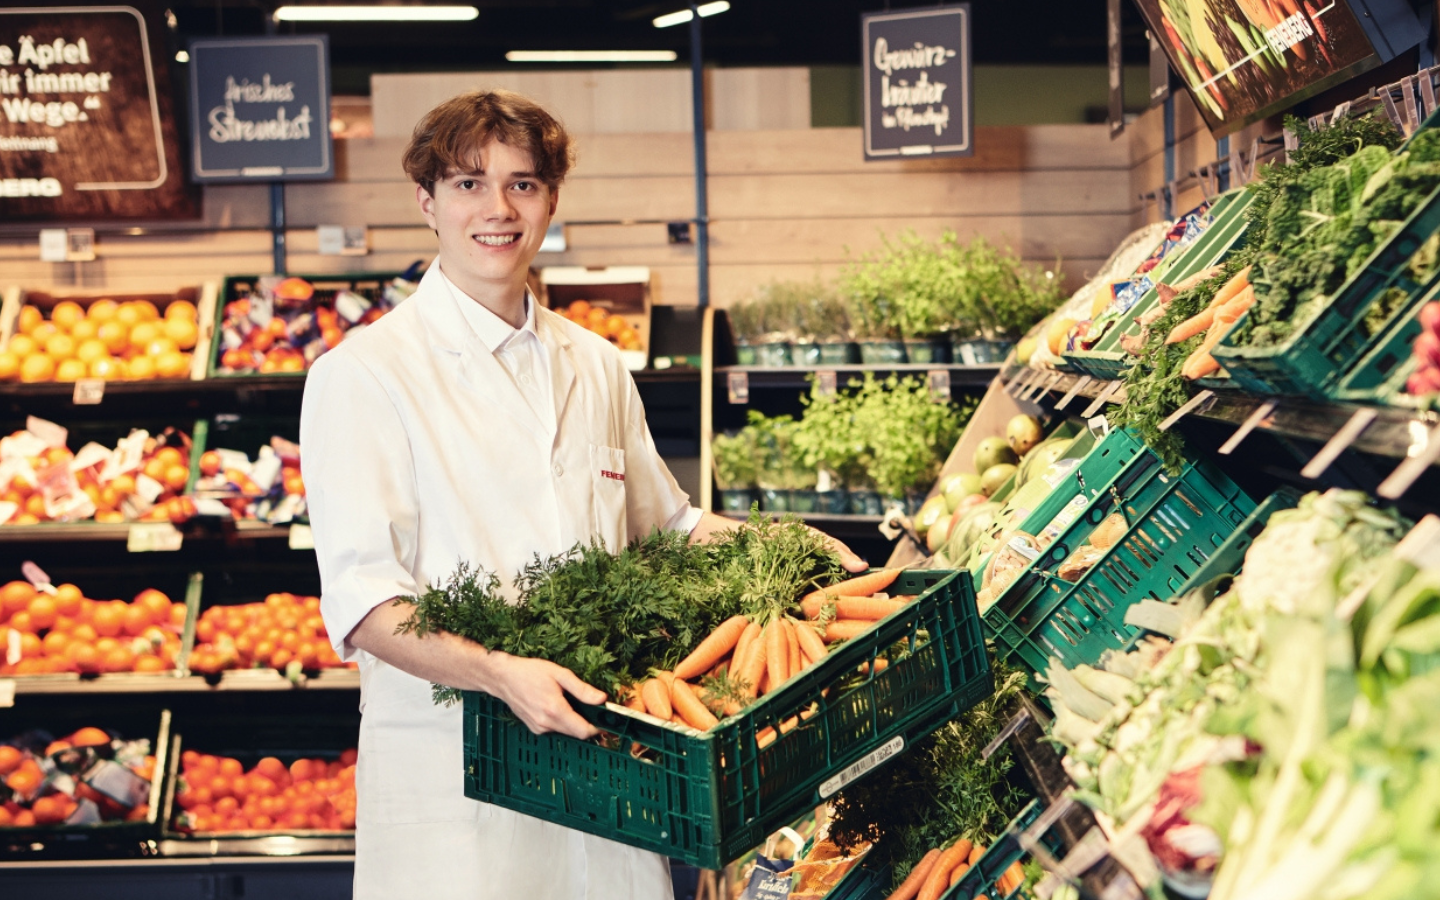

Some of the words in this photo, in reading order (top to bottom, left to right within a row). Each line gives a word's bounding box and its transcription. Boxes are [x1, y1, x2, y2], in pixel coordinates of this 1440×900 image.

[1264, 10, 1314, 54] FENEBERG
[18, 35, 91, 69] Äpfel
[874, 36, 957, 76] Gewürz-
[24, 68, 112, 93] immer
[224, 73, 295, 112] frisches
[208, 104, 313, 143] Streuobst
